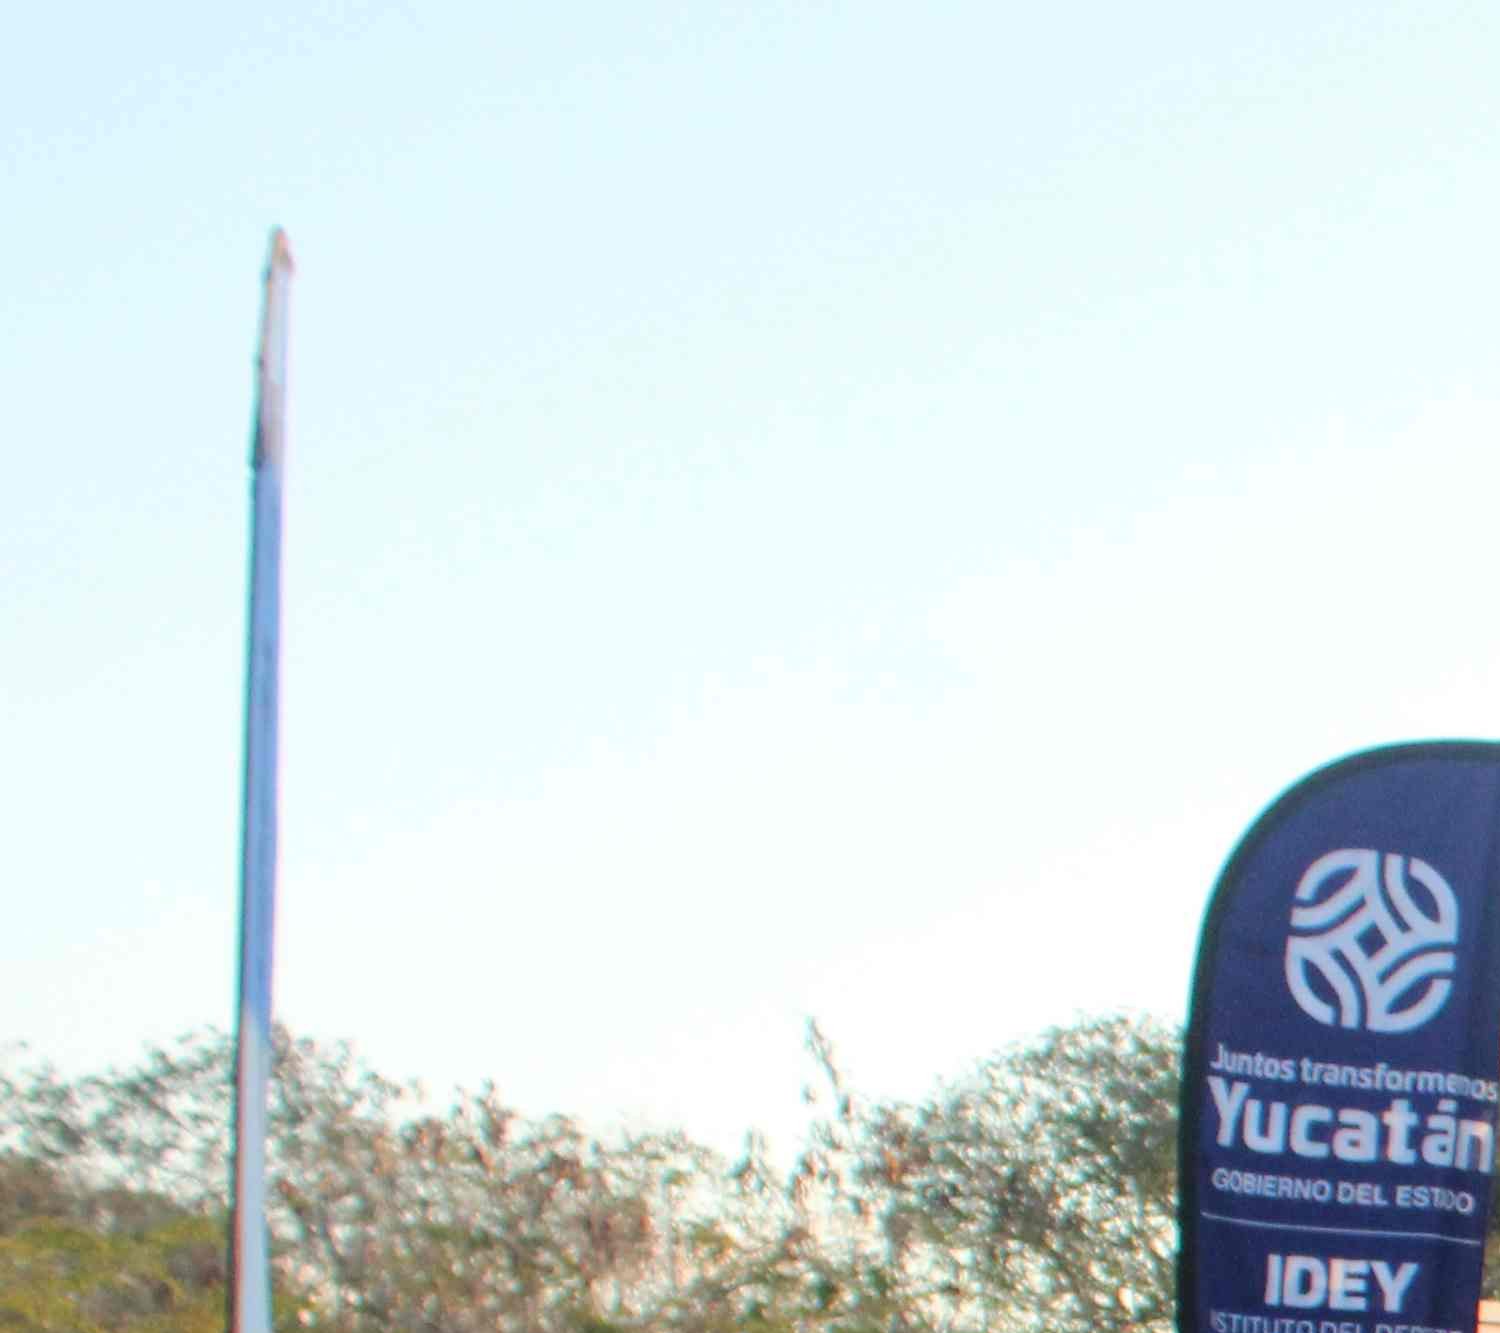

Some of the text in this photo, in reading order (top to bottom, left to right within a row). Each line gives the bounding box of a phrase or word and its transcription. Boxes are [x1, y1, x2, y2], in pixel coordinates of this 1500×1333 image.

[1209, 1042, 1296, 1081] Juntos
[1207, 1075, 1496, 1174] Yucatán
[1211, 1166, 1331, 1204] GOBIERNO
[1335, 1180, 1388, 1207] DEL
[1264, 1252, 1420, 1313] IDEY
